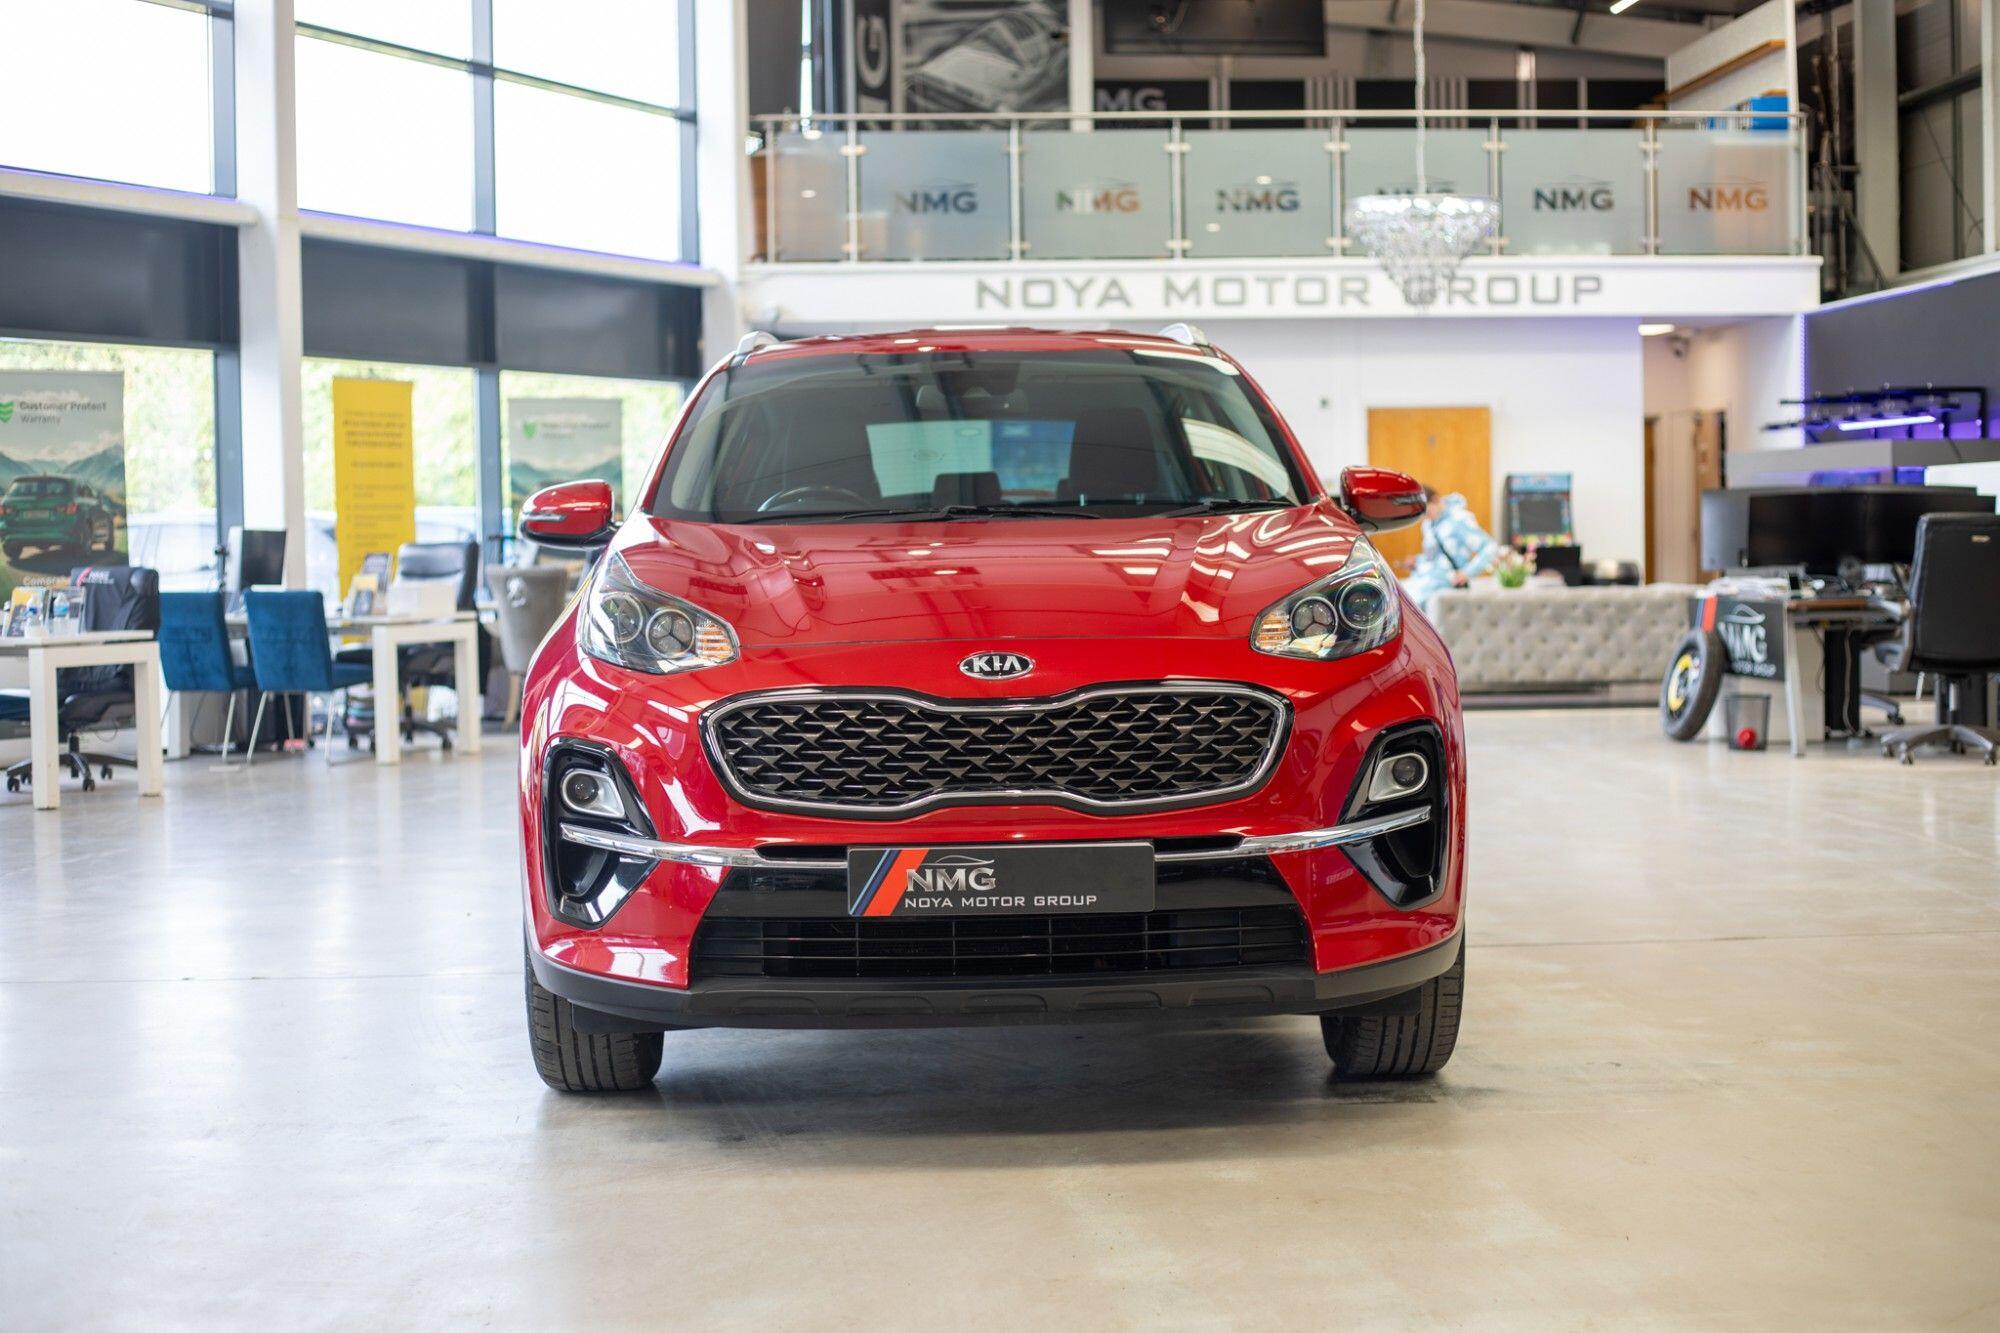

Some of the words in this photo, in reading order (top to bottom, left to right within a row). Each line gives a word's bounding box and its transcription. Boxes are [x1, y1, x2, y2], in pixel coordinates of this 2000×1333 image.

[895, 190, 978, 214] NMG
[1217, 190, 1299, 213] NMG
[1534, 187, 1614, 211] NMG
[1689, 187, 1768, 211] NMG
[976, 278, 1132, 309] NOYA
[1164, 276, 1370, 307] MOTOR
[19, 401, 67, 411] Customer
[20, 414, 60, 426] Warranty
[972, 655, 1022, 673] KIA
[906, 867, 996, 892] NMG
[904, 896, 952, 908] NOYA
[961, 896, 1025, 908] MOTOR
[1034, 895, 1097, 906] GROUP
